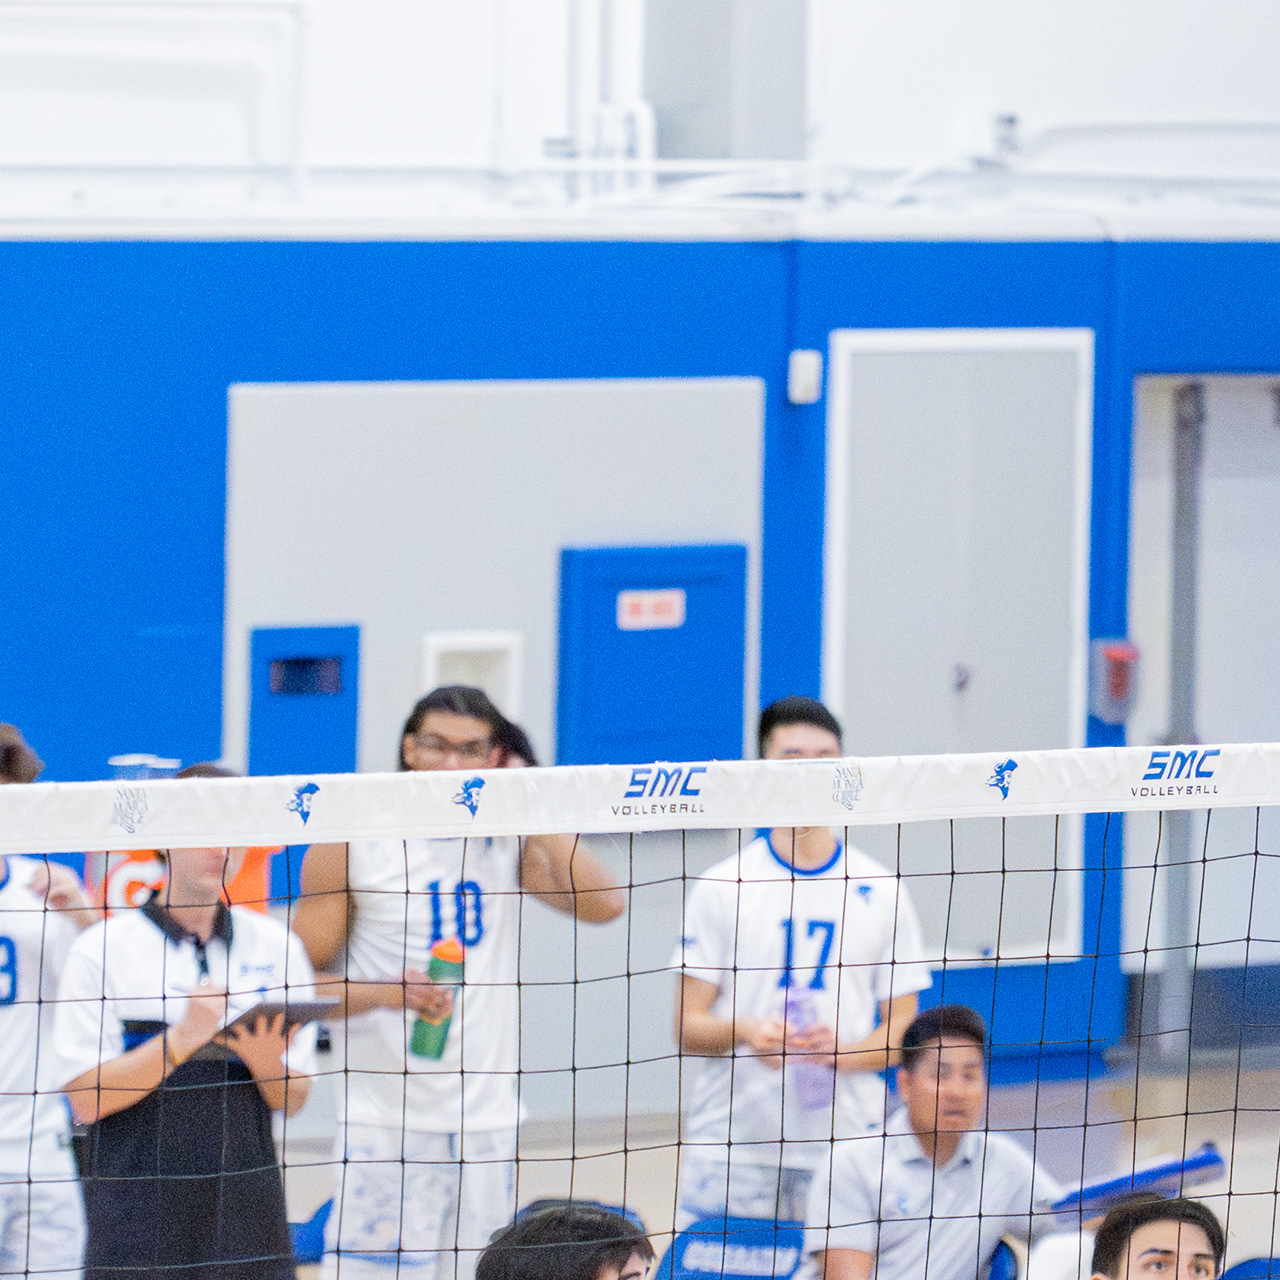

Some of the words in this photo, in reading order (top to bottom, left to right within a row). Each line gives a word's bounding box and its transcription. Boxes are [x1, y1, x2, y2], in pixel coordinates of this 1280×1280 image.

[1142, 749, 1221, 781] SMC
[623, 766, 707, 799] SMC
[1130, 784, 1219, 797] VOLLEYBALL
[611, 803, 705, 816] VOLLEYBALL
[777, 918, 836, 990] 17
